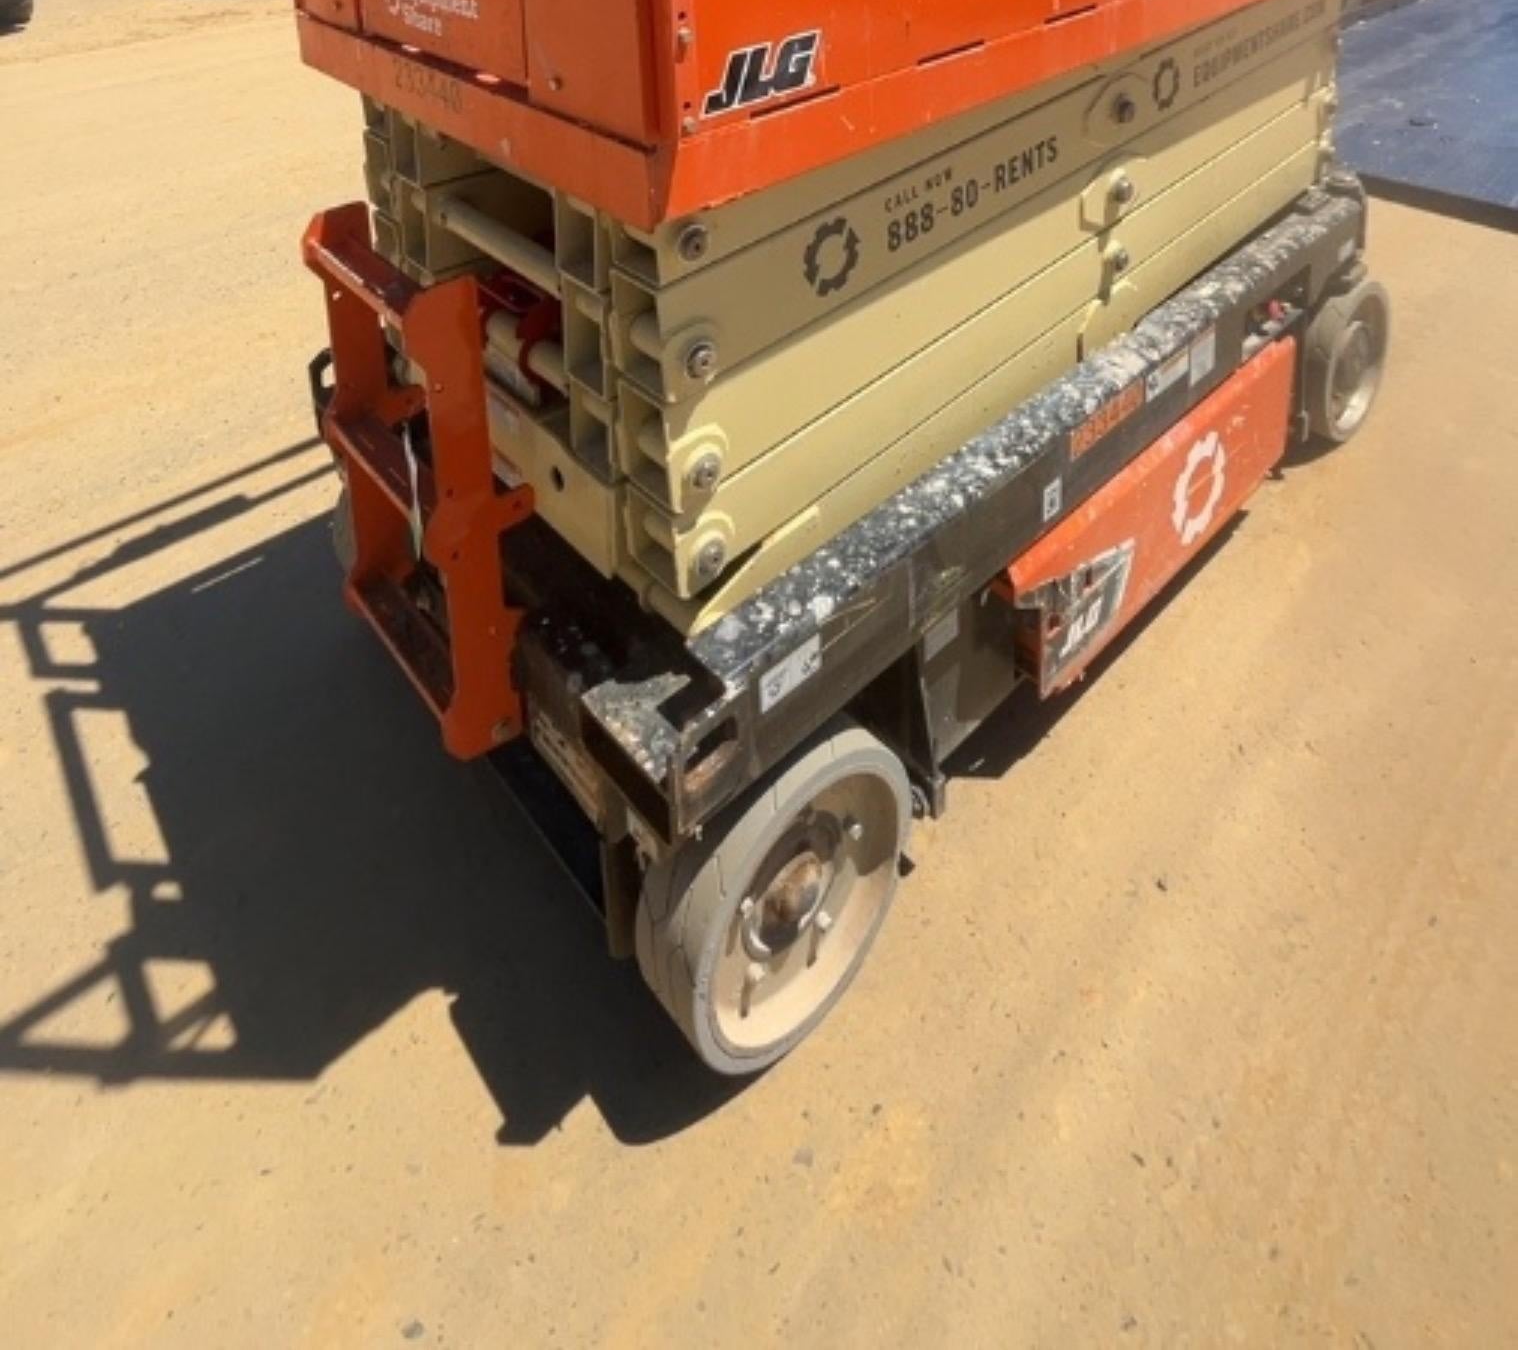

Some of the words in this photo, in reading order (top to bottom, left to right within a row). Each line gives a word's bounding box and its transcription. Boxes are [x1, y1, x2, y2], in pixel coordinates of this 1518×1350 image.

[401, 3, 442, 37] Share
[700, 29, 822, 119] JLG
[884, 186, 919, 213] CALL
[925, 166, 952, 190] NOW
[886, 136, 1057, 252] 888-80-RENTS
